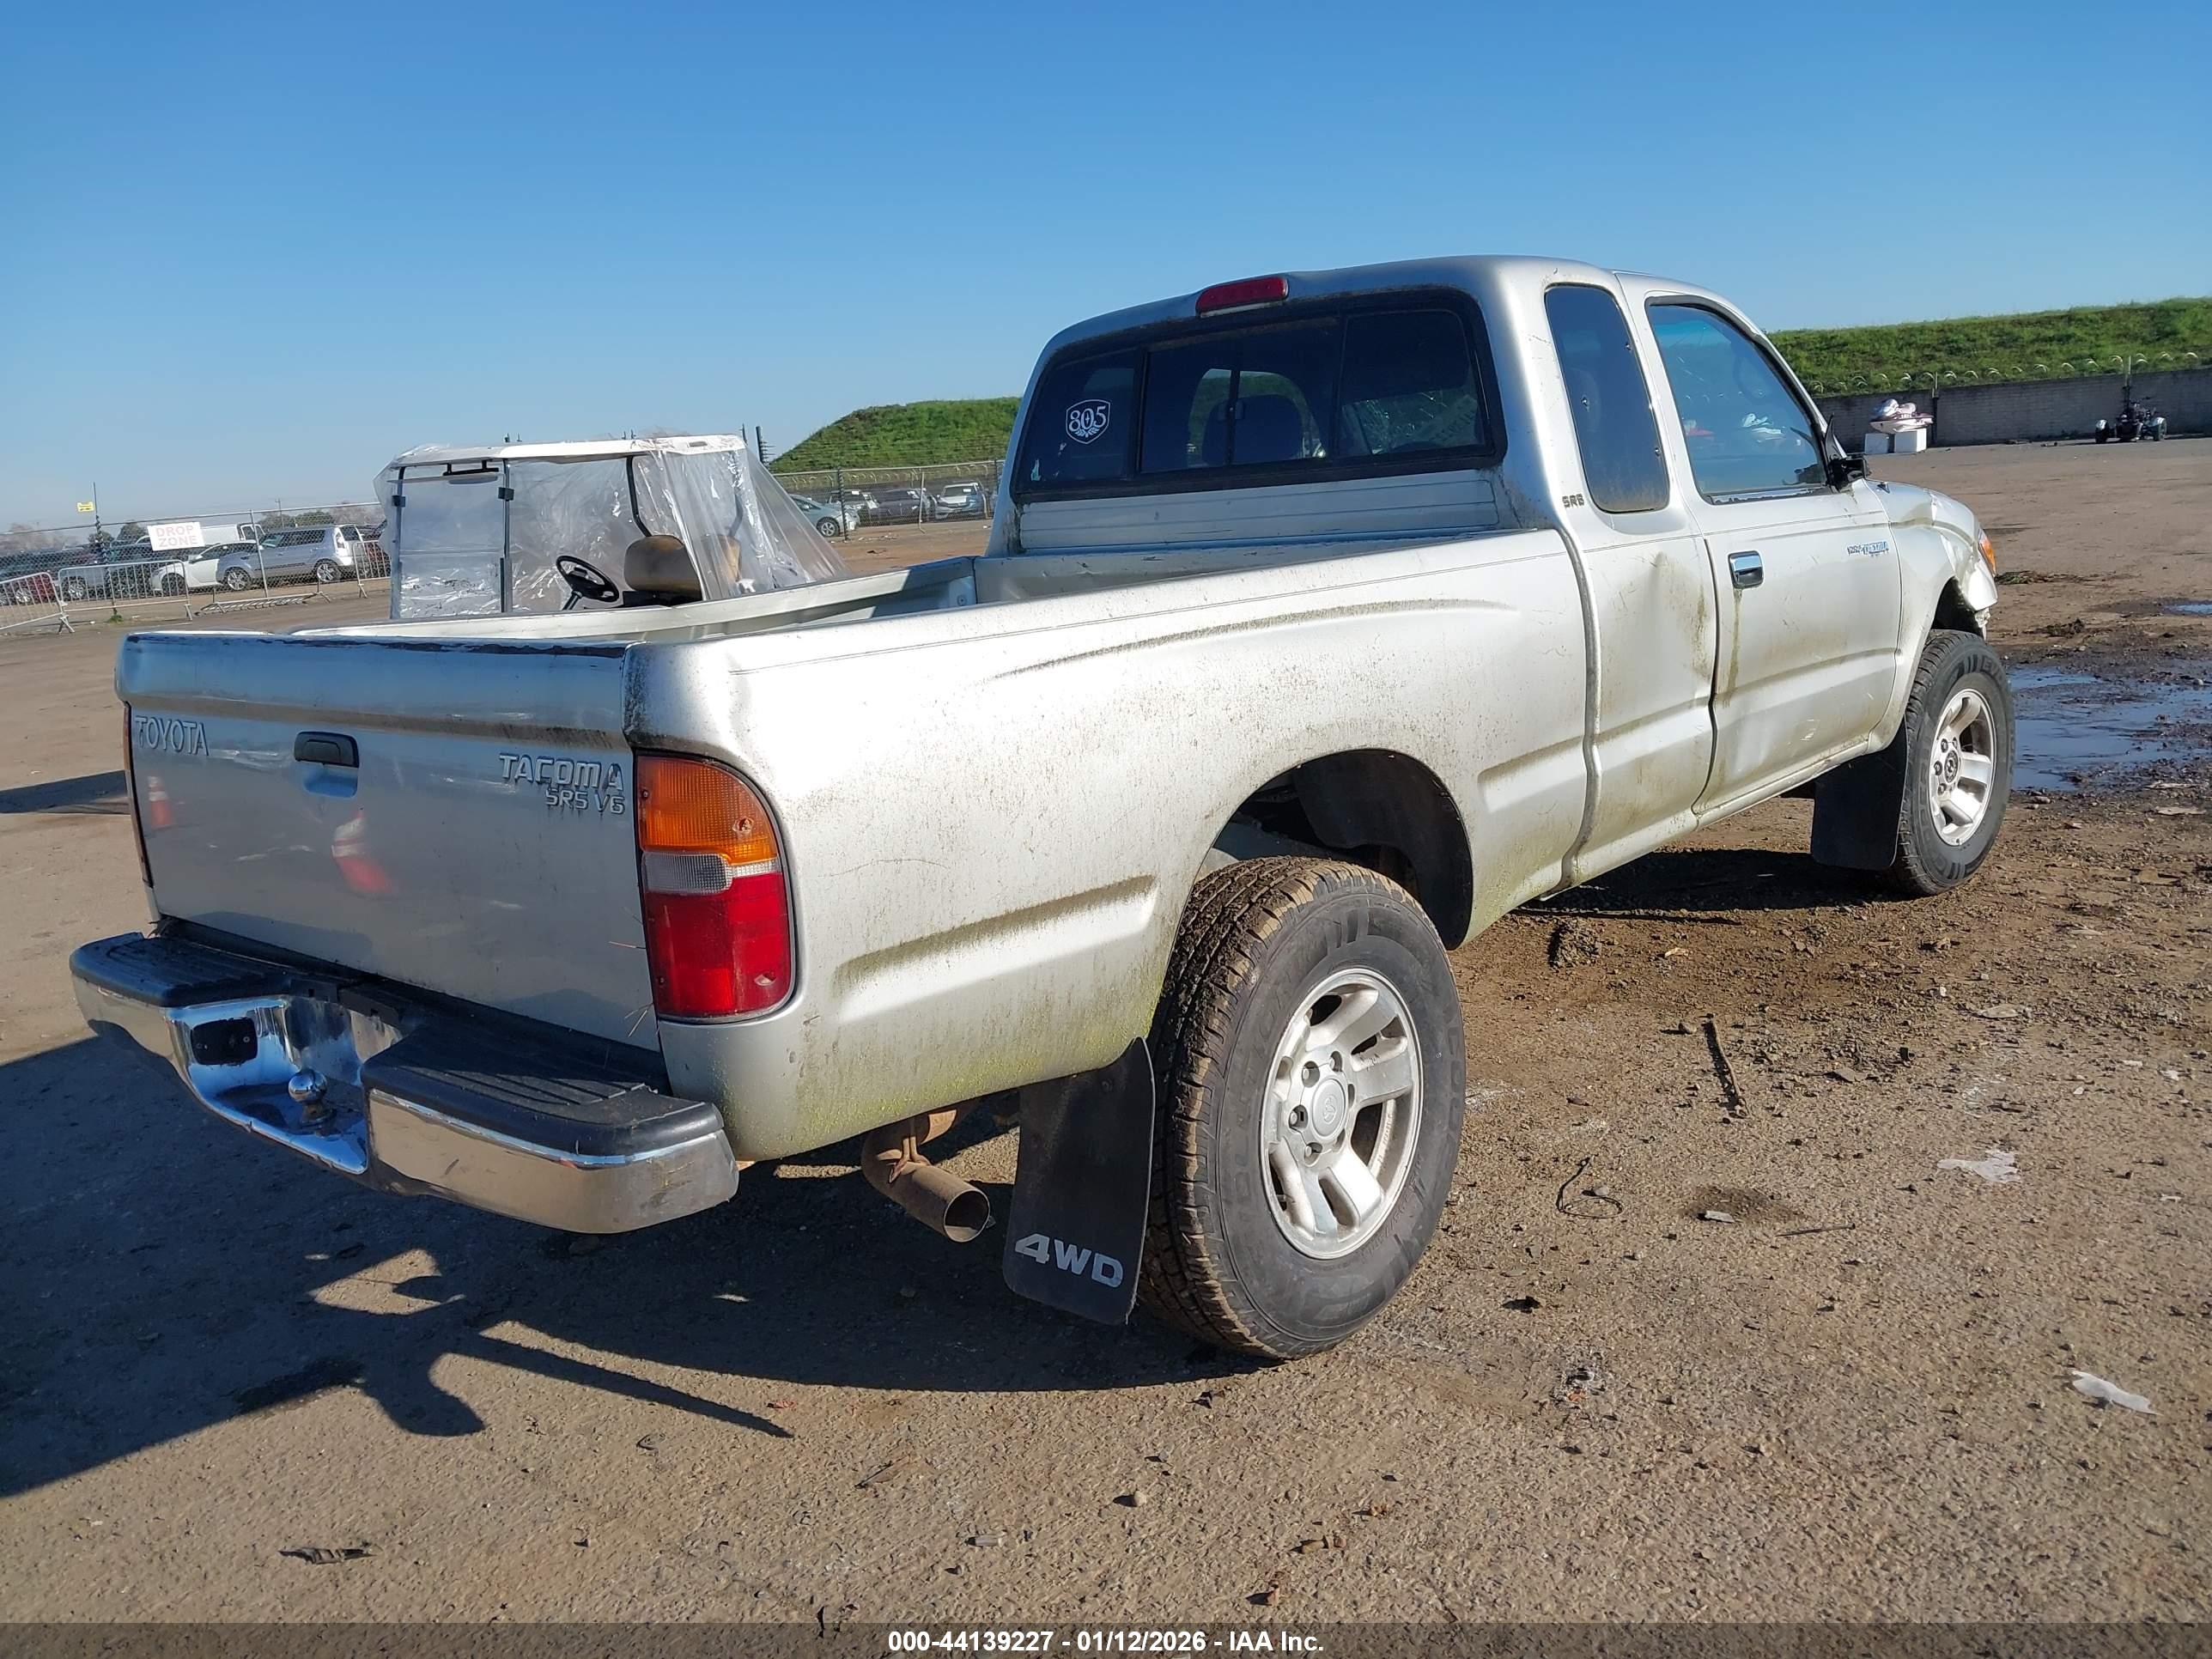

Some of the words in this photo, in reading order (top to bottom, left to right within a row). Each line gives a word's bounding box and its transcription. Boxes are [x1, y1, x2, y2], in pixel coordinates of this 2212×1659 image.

[1068, 405, 1107, 432] 805
[155, 525, 194, 537] DROP
[158, 536, 198, 547] ZONE
[133, 714, 210, 757] TOYOTA
[498, 752, 625, 792] TACOMA
[544, 787, 589, 811] SR5
[593, 793, 626, 815] V6
[1014, 1232, 1124, 1289] 4WD
